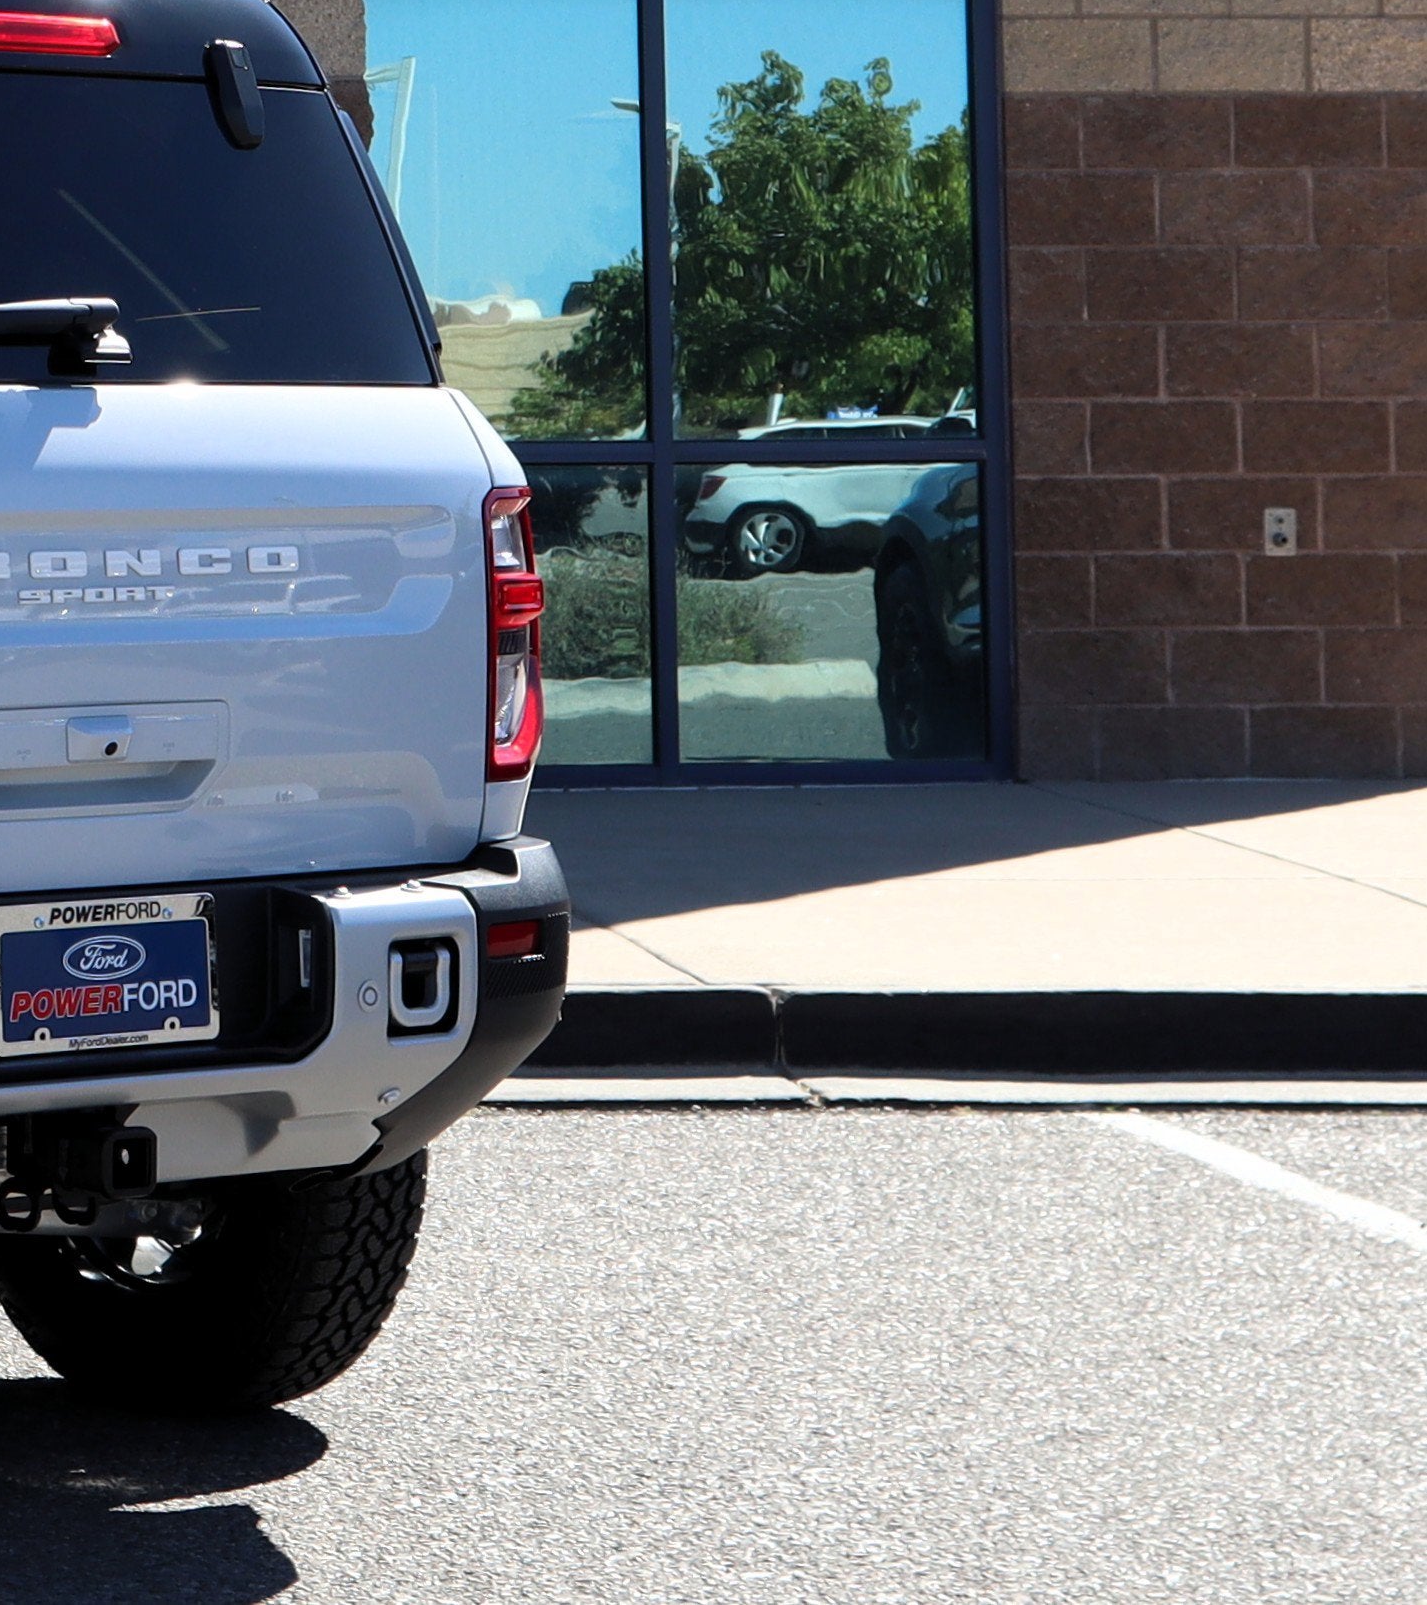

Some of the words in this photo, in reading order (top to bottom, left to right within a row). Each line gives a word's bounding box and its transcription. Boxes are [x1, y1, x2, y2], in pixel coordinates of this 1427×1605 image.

[18, 585, 176, 605] SPORT
[79, 944, 129, 971] Ford
[68, 1034, 149, 1051] MyFordDealer.com
